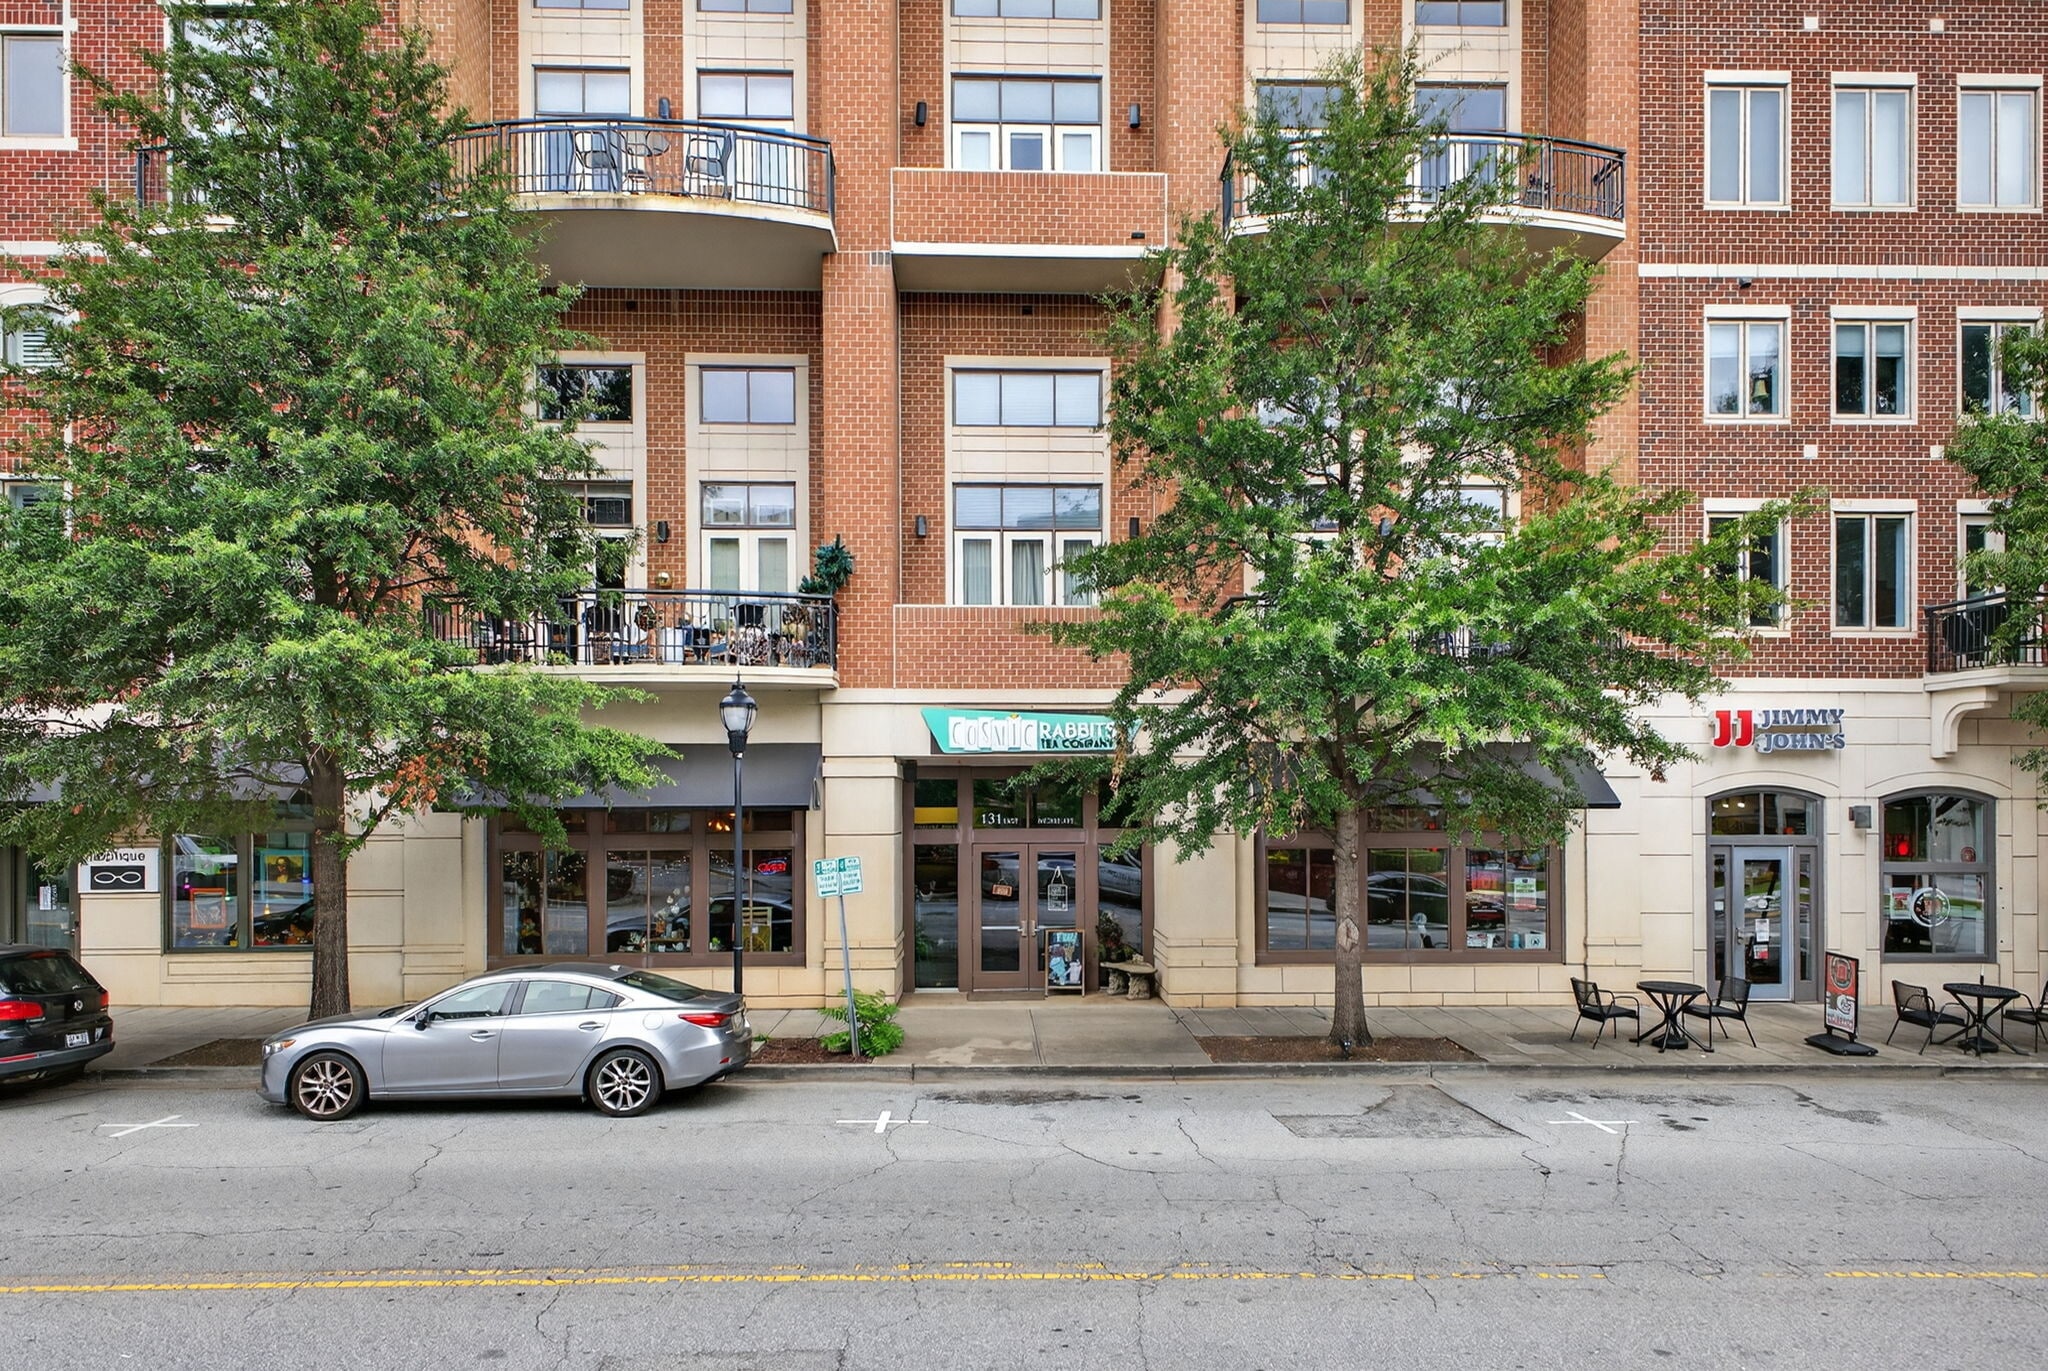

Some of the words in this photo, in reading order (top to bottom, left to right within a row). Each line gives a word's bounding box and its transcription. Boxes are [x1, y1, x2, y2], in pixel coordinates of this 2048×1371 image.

[1760, 709, 1845, 728] JIMMY
[949, 719, 1037, 747] COSMIC
[1713, 710, 1753, 747] JJ
[1041, 738, 1058, 749] TEA
[1762, 733, 1846, 752] JOHN'S
[981, 812, 1000, 825] 131
